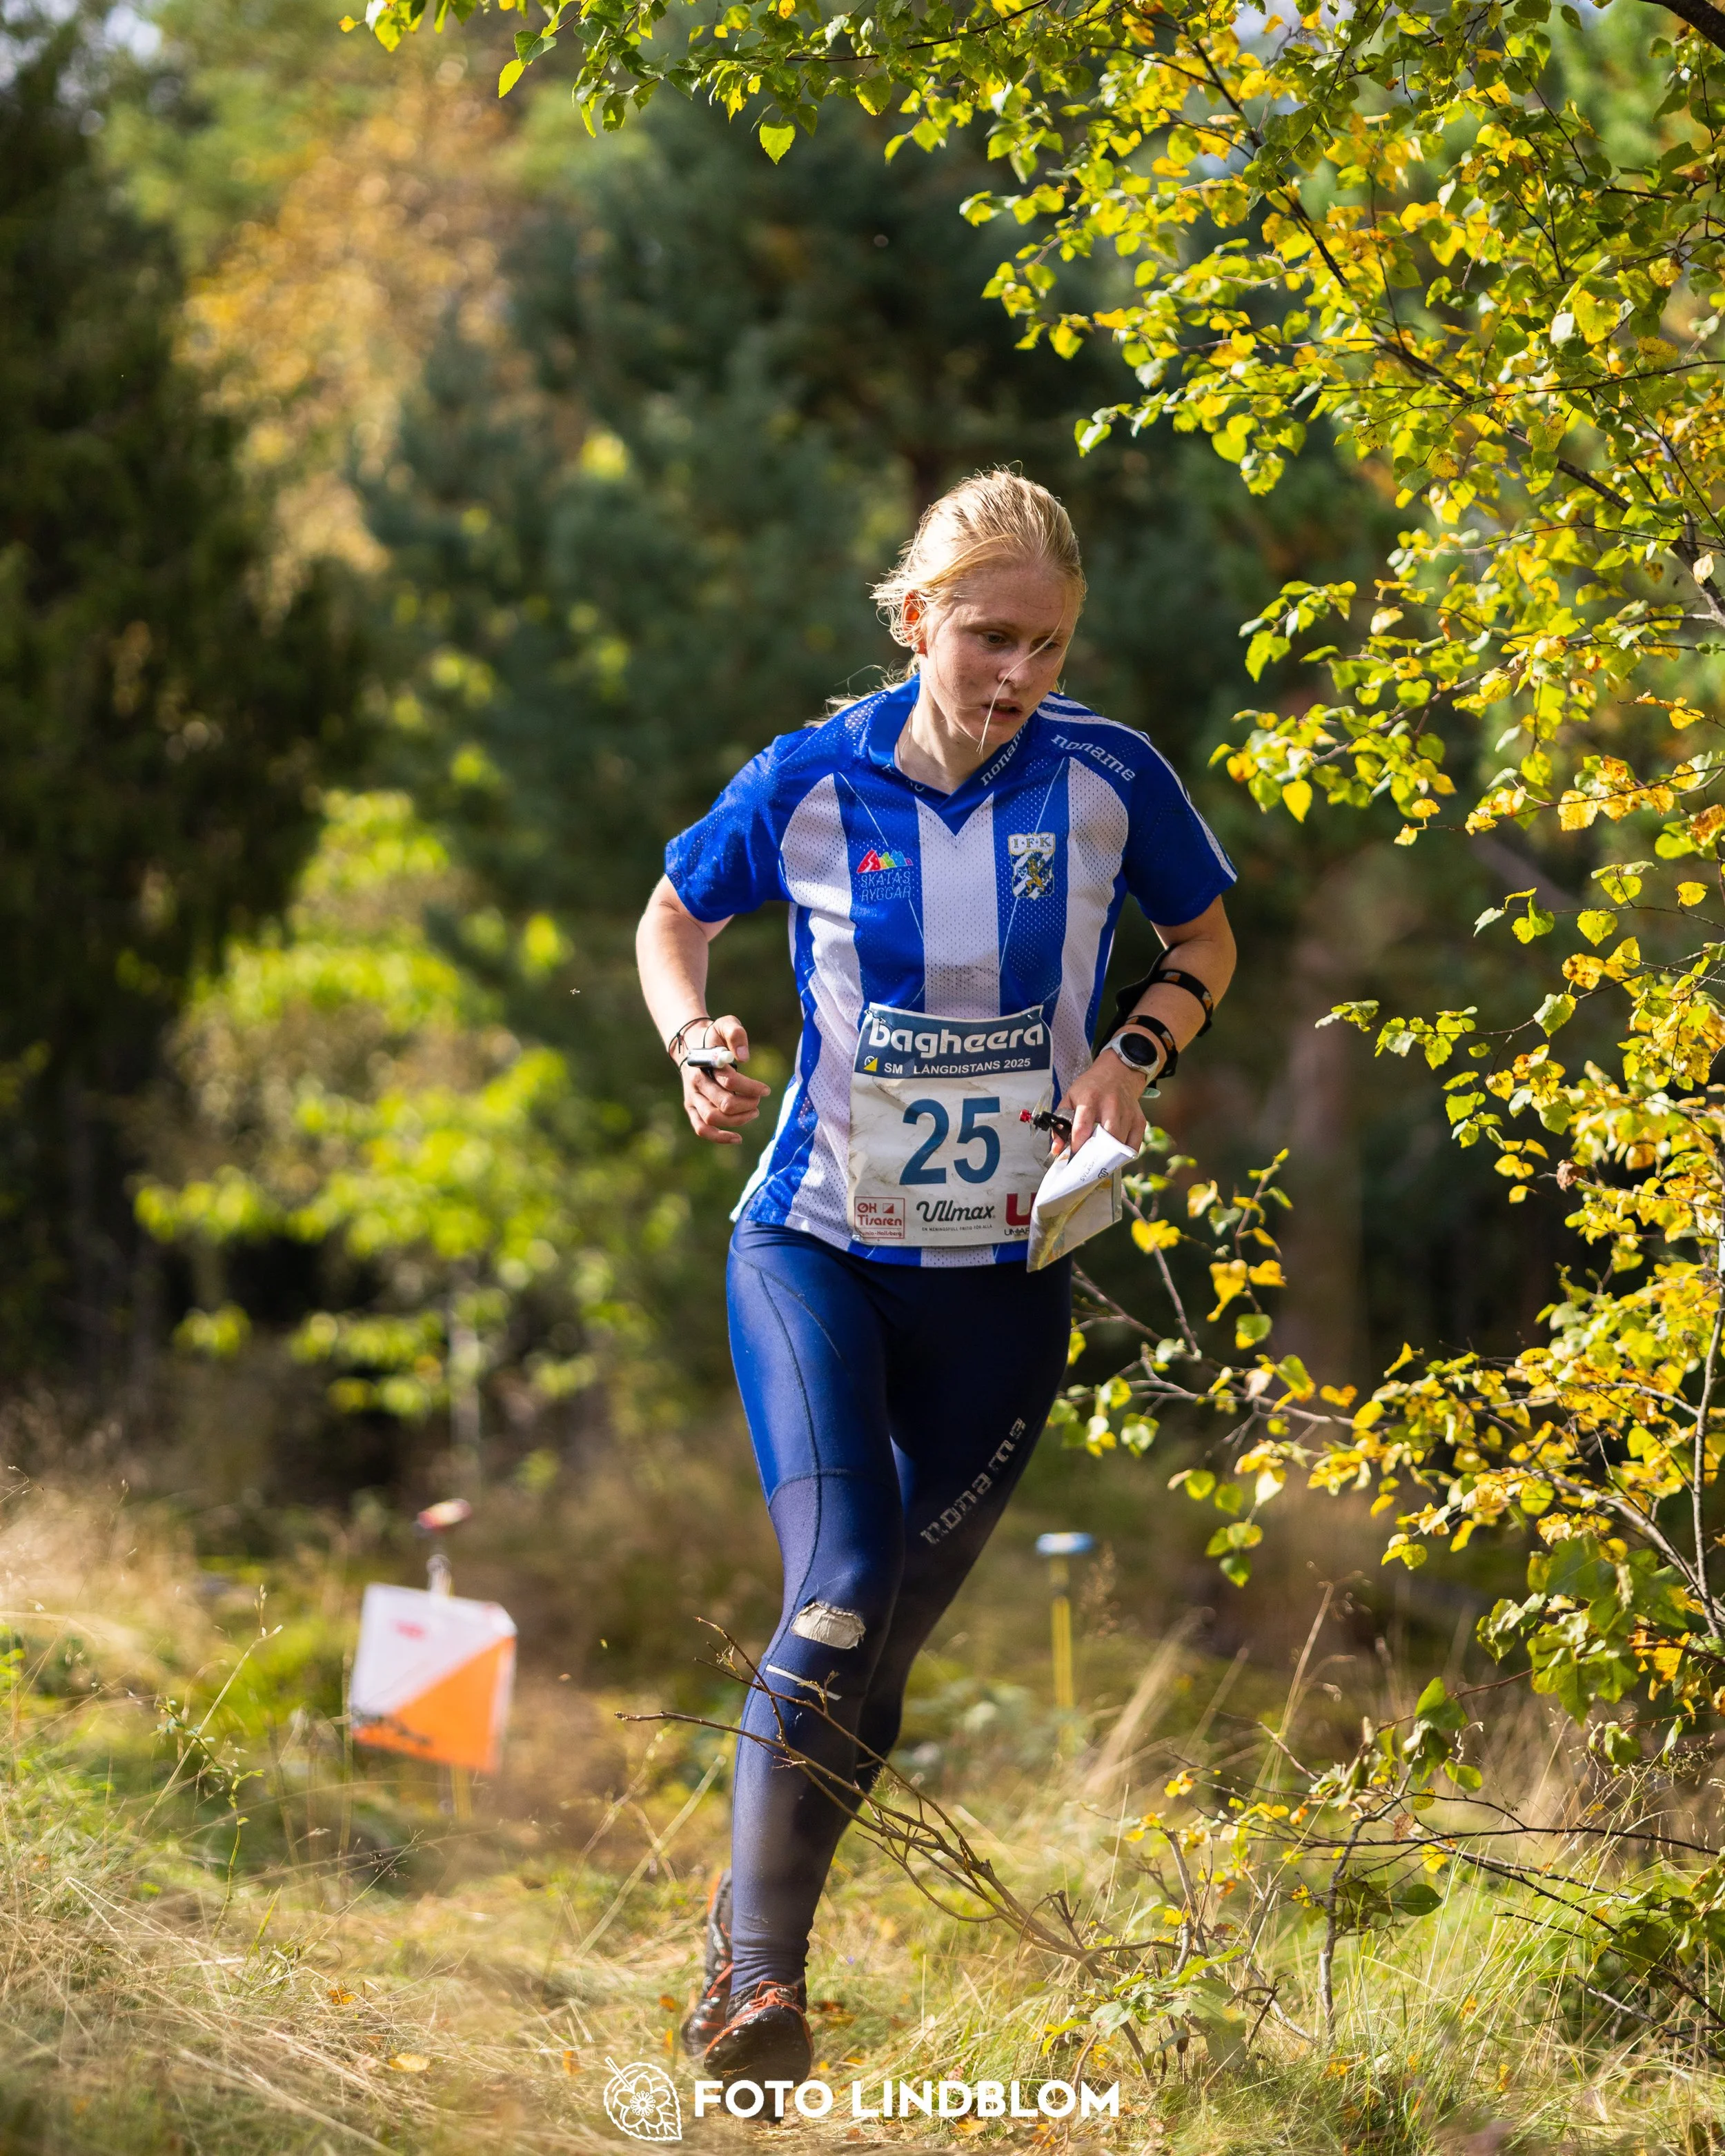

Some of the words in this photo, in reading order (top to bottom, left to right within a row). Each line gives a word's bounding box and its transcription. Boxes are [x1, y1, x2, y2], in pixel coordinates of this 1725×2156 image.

[1051, 734, 1136, 781] noname
[861, 885, 911, 902] RYGGAR
[869, 1018, 1044, 1058] bagheera
[884, 1062, 903, 1074] SM
[914, 1059, 1000, 1075] LÅNGDISTANS
[1004, 1058, 1031, 1069] 2025
[899, 1096, 1000, 1185] 25
[858, 1214, 902, 1226] Tisaren
[916, 1200, 995, 1223] Ullmax
[920, 1417, 1027, 1545] noname
